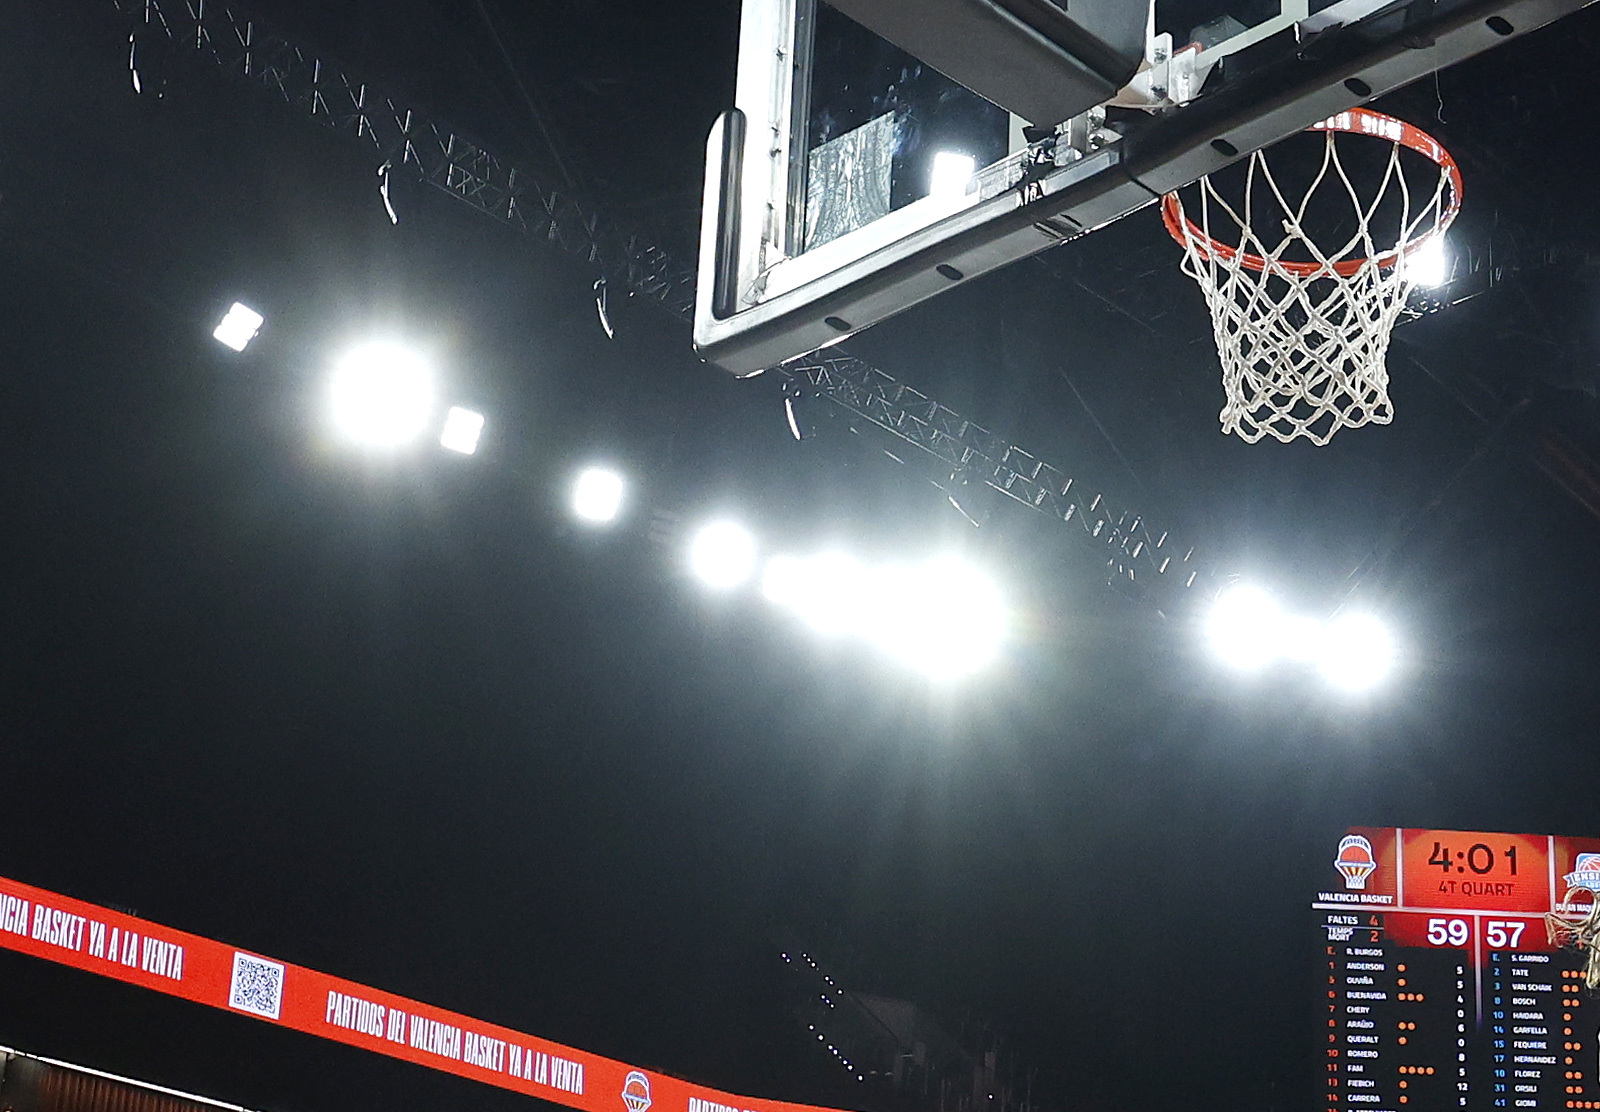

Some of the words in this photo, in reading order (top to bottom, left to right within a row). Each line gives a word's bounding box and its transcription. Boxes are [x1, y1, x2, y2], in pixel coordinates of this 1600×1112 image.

[1428, 842, 1517, 876] 4:01
[1438, 881, 1457, 894] 4T
[1461, 881, 1515, 896] QUART
[1318, 892, 1359, 903] VALENCIA
[1361, 893, 1393, 904] BASKET
[1327, 915, 1359, 925] FALTES
[1369, 915, 1379, 926] 4
[1370, 931, 1379, 943] 2
[1427, 918, 1469, 946] 59
[1486, 921, 1525, 948] 57
[31, 904, 86, 952] BASKET
[89, 920, 107, 959] YA
[107, 927, 119, 962] A
[121, 930, 139, 968] LA
[141, 936, 184, 981] VENTA
[1456, 967, 1463, 975] 5
[1493, 968, 1501, 976] 2
[1511, 969, 1529, 977] TATE
[1456, 981, 1464, 989] 5
[1494, 982, 1501, 990] 3
[1457, 996, 1464, 1004] 4
[1328, 1005, 1336, 1013] 7
[1457, 1010, 1464, 1018] 0
[1493, 1011, 1504, 1019] 10
[1457, 1024, 1465, 1032] 6
[1493, 1025, 1505, 1034] 14
[326, 990, 386, 1038] PARTIDOS
[387, 1008, 408, 1045] DEL
[410, 1014, 462, 1061] VALENCIA
[464, 1031, 506, 1073] BASKET
[508, 1043, 523, 1078] YA
[523, 1048, 533, 1081] A
[534, 1052, 548, 1086] LA
[550, 1056, 584, 1096] VENTA
[1347, 1035, 1379, 1044] QUERALT
[1457, 1039, 1465, 1047] 0
[1493, 1040, 1505, 1048] 15
[1327, 1050, 1339, 1058] 10
[1347, 1050, 1379, 1059] ROMERO
[1458, 1053, 1465, 1062] 8
[1494, 1054, 1505, 1063] 17
[1327, 1064, 1339, 1072] 11
[1347, 1065, 1364, 1073] FAM
[1458, 1068, 1466, 1076] 5
[1457, 1083, 1468, 1091] 12
[1494, 1084, 1505, 1092] 31
[1347, 1094, 1381, 1103] CARRERA
[1459, 1097, 1466, 1106] 5
[1494, 1099, 1506, 1107] 41
